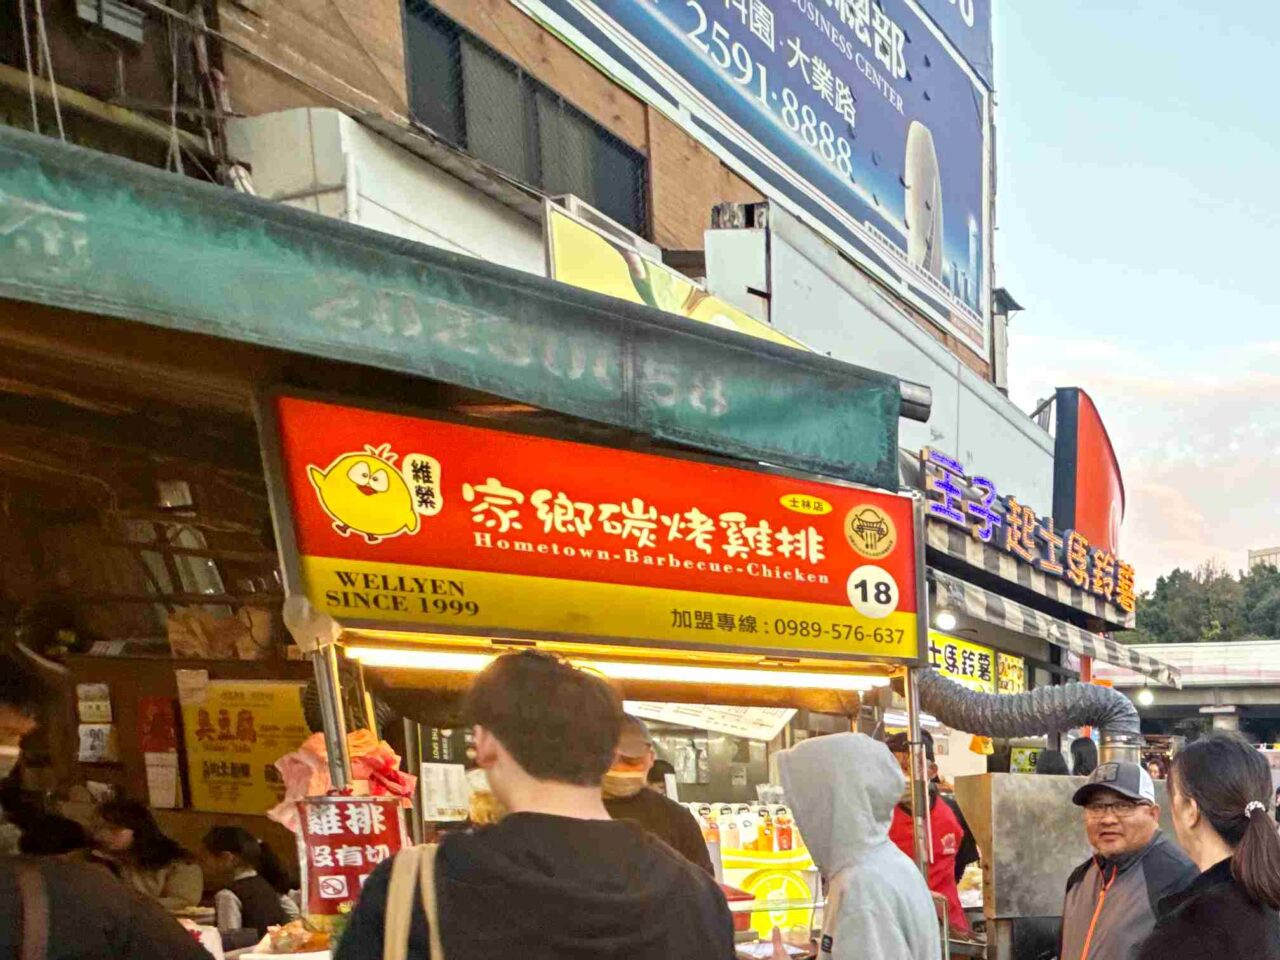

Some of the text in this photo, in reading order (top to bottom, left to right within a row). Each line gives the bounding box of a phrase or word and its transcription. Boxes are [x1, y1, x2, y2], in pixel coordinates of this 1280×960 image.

[795, 0, 905, 116] USINESS CENTER
[788, 496, 824, 513] 士林店
[462, 477, 826, 564] 家鄉碳烤雞排
[473, 531, 830, 585] Hometown-Barbecue-Chicken
[334, 570, 465, 597] WELLYEN
[853, 578, 892, 606] 18
[325, 589, 480, 616] SINCE 1999
[306, 803, 387, 835] 雞排
